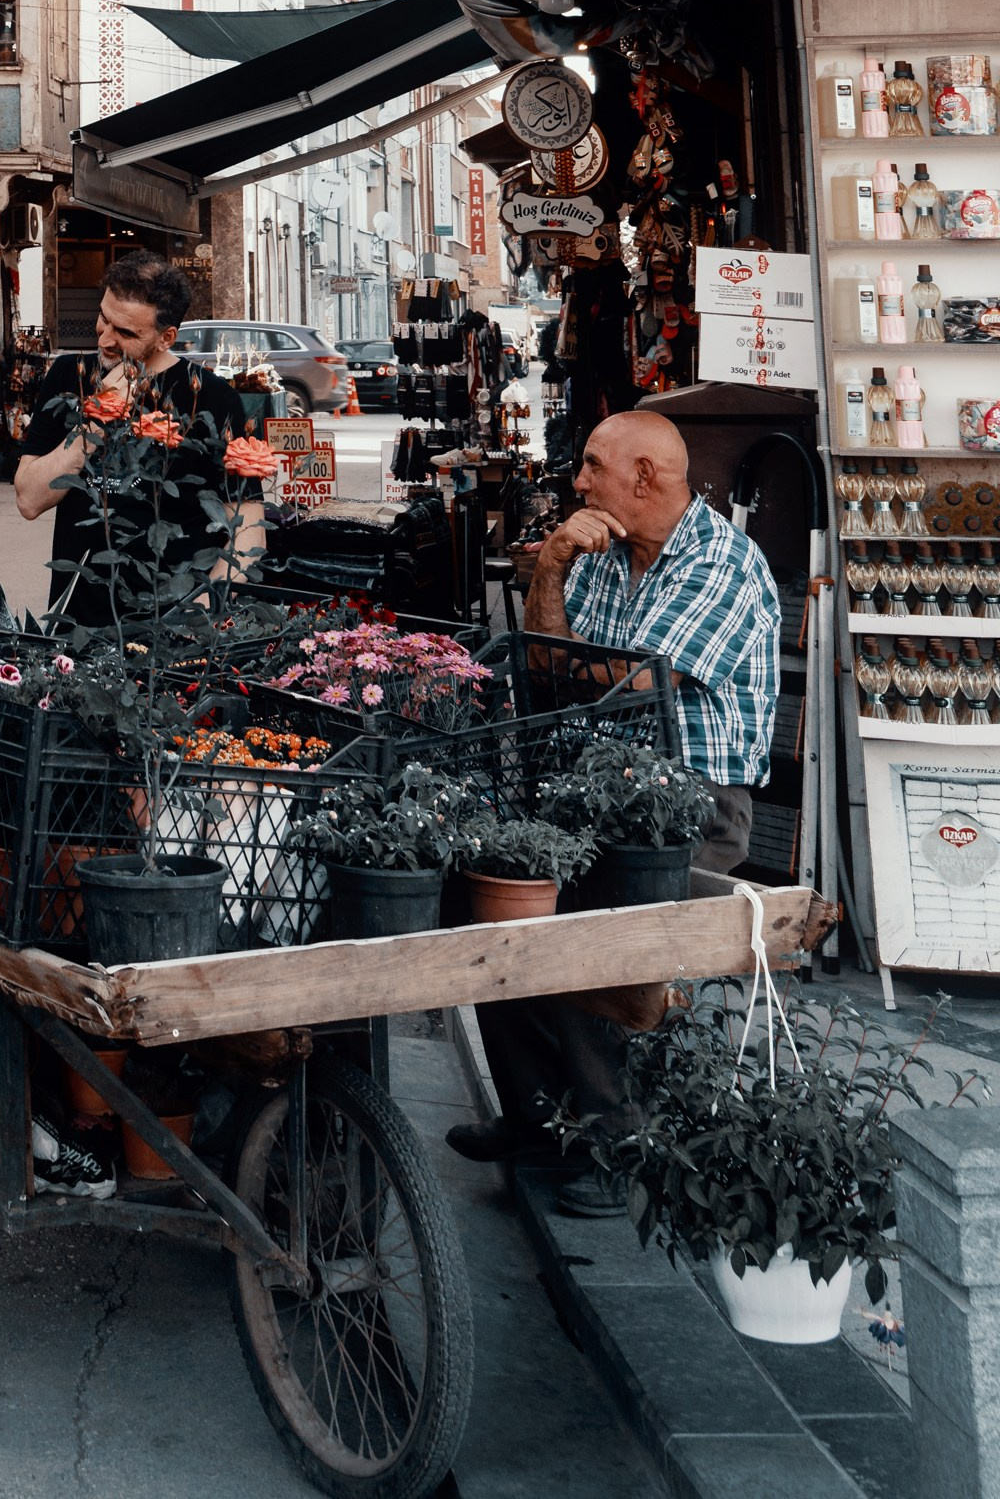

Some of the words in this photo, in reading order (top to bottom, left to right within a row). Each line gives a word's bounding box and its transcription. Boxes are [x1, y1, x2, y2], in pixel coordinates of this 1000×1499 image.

[471, 172, 485, 254] KIRMIZI
[513, 203, 538, 219] Hoş
[540, 200, 597, 225] Geldiniz
[730, 366, 749, 376] 350g
[773, 370, 791, 378] Adet
[283, 434, 305, 451] 200
[283, 483, 331, 495] BOYASI
[902, 763, 948, 774] Konya
[942, 828, 974, 842] ÖZKAR
